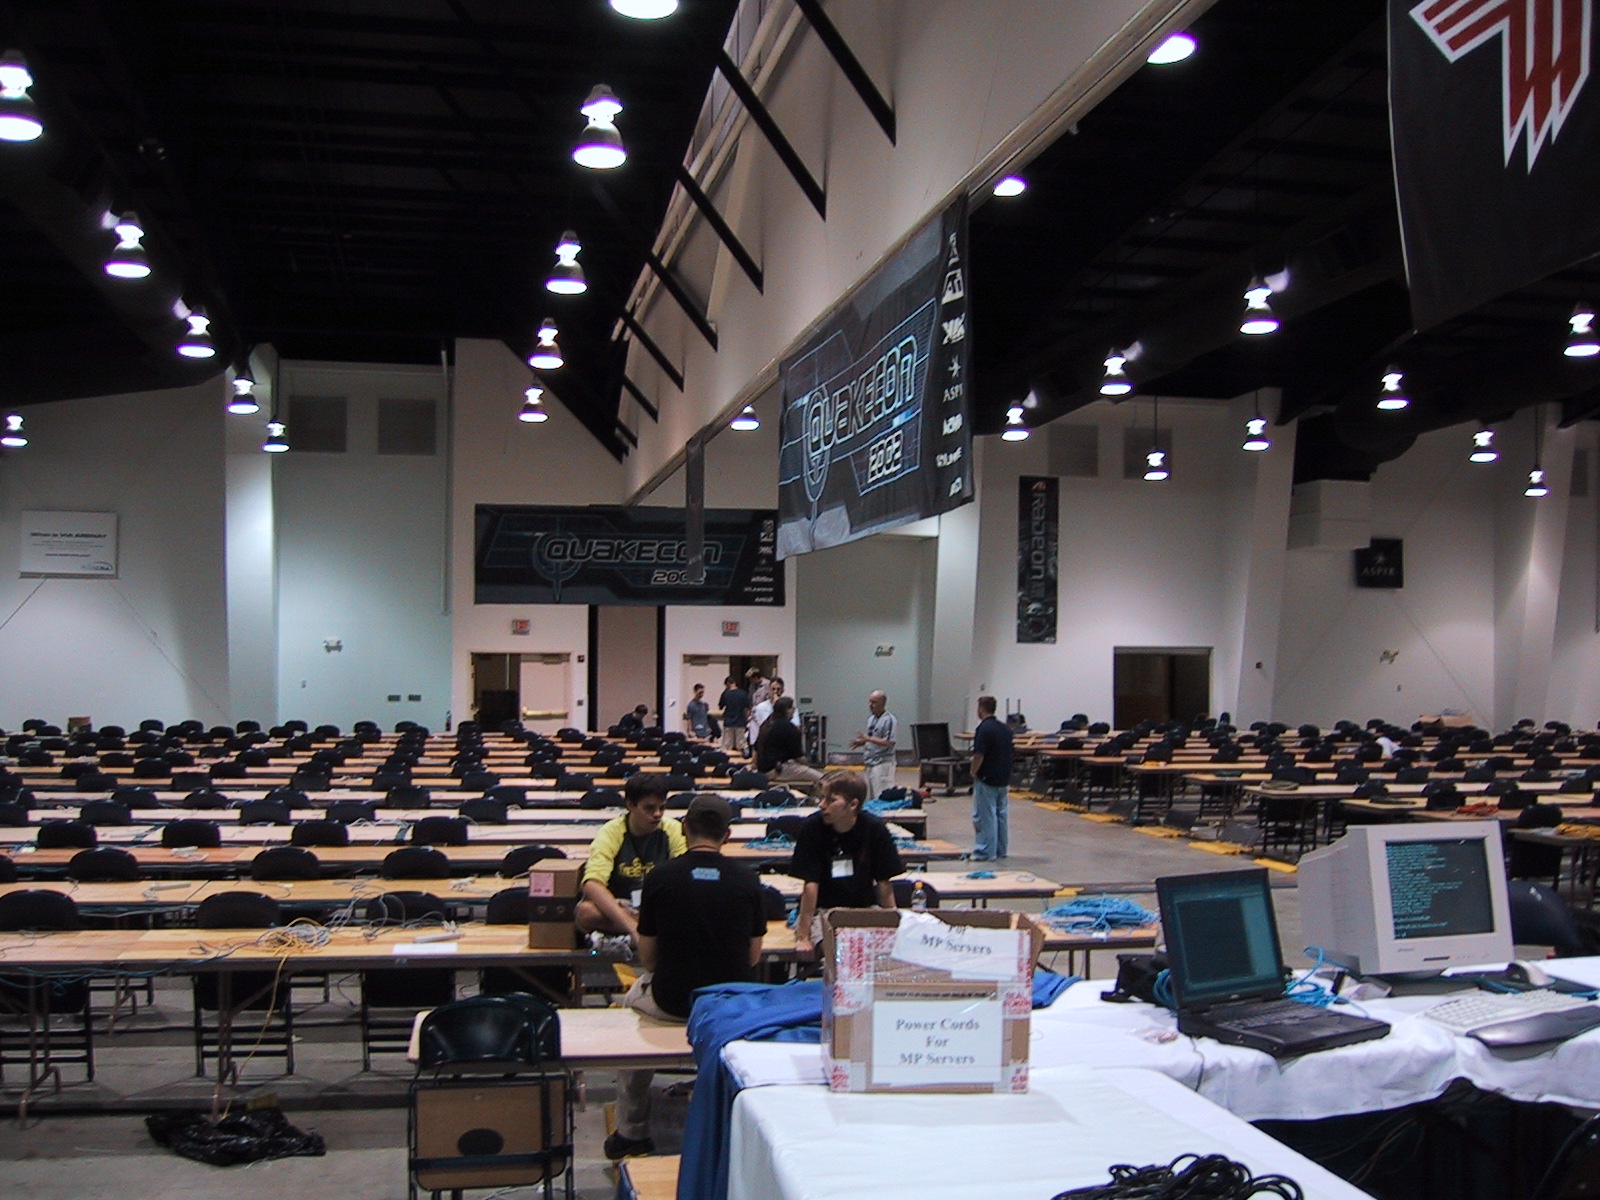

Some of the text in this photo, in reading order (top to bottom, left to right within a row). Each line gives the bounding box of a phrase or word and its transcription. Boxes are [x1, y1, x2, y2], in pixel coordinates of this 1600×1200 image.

[867, 430, 904, 484] 2002
[921, 934, 993, 956] MP Servers
[896, 1018, 980, 1031] Power Cords
[926, 1035, 950, 1048] For
[900, 1053, 976, 1065] MP Servers
